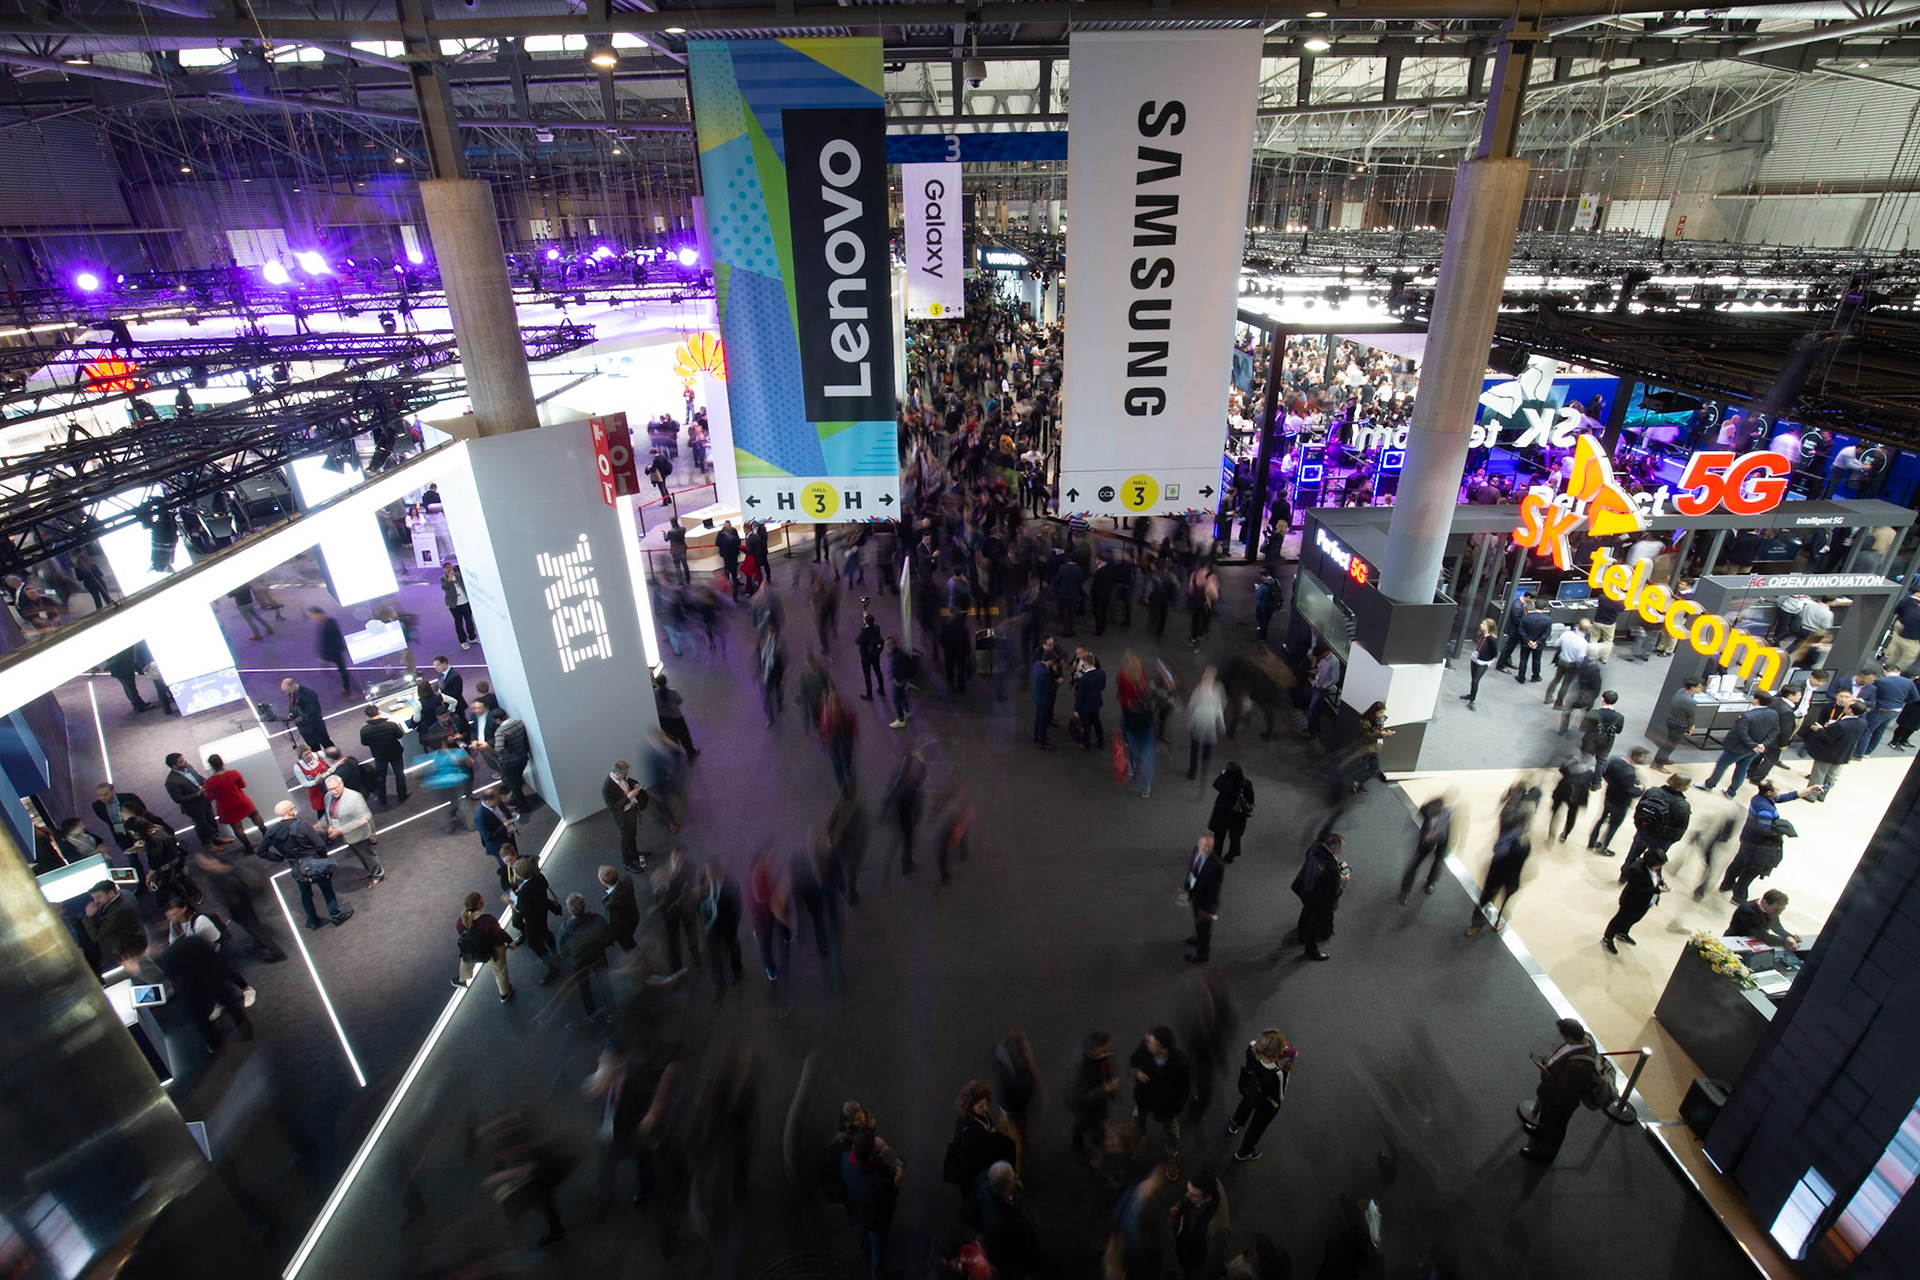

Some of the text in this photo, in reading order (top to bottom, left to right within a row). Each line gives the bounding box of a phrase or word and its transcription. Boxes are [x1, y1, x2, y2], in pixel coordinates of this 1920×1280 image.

[944, 134, 962, 162] 3
[922, 179, 945, 279] Galaxy
[819, 138, 872, 397] Lenovo
[985, 252, 1029, 266] vmware
[1124, 100, 1186, 416] SAMSUNG
[777, 491, 862, 513] H 3 H
[1133, 487, 1145, 506] 3
[1672, 450, 1792, 517] 5G
[1511, 494, 1583, 571] SK
[1796, 517, 1845, 526] Intelligent 5G
[1316, 527, 1369, 584] Perfect 5G
[1748, 576, 1886, 588] 5G OPEN INNOVATION
[1588, 546, 1785, 692] telecom
